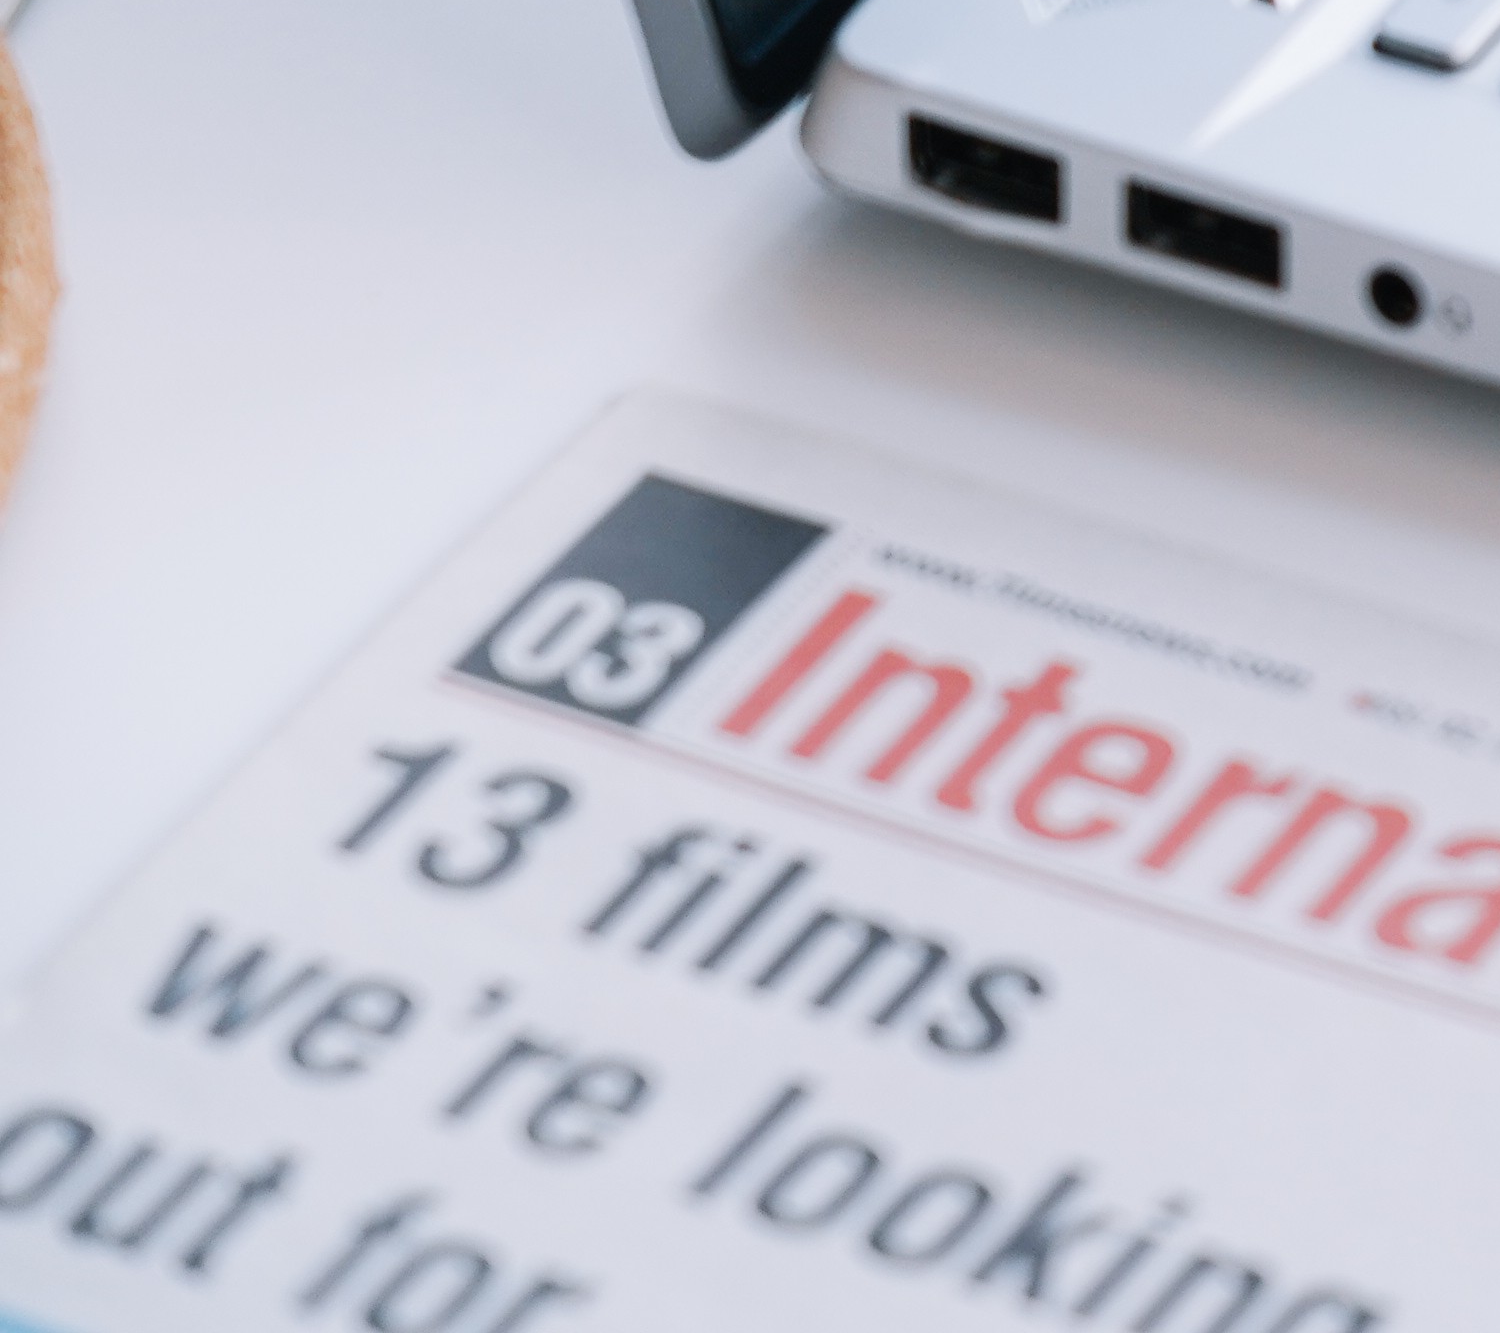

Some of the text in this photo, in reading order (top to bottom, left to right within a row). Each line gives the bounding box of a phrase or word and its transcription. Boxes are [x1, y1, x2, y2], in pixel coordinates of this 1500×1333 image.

[487, 579, 704, 711] 03
[333, 731, 1051, 1061] 13 films
[0, 1101, 297, 1278] out
